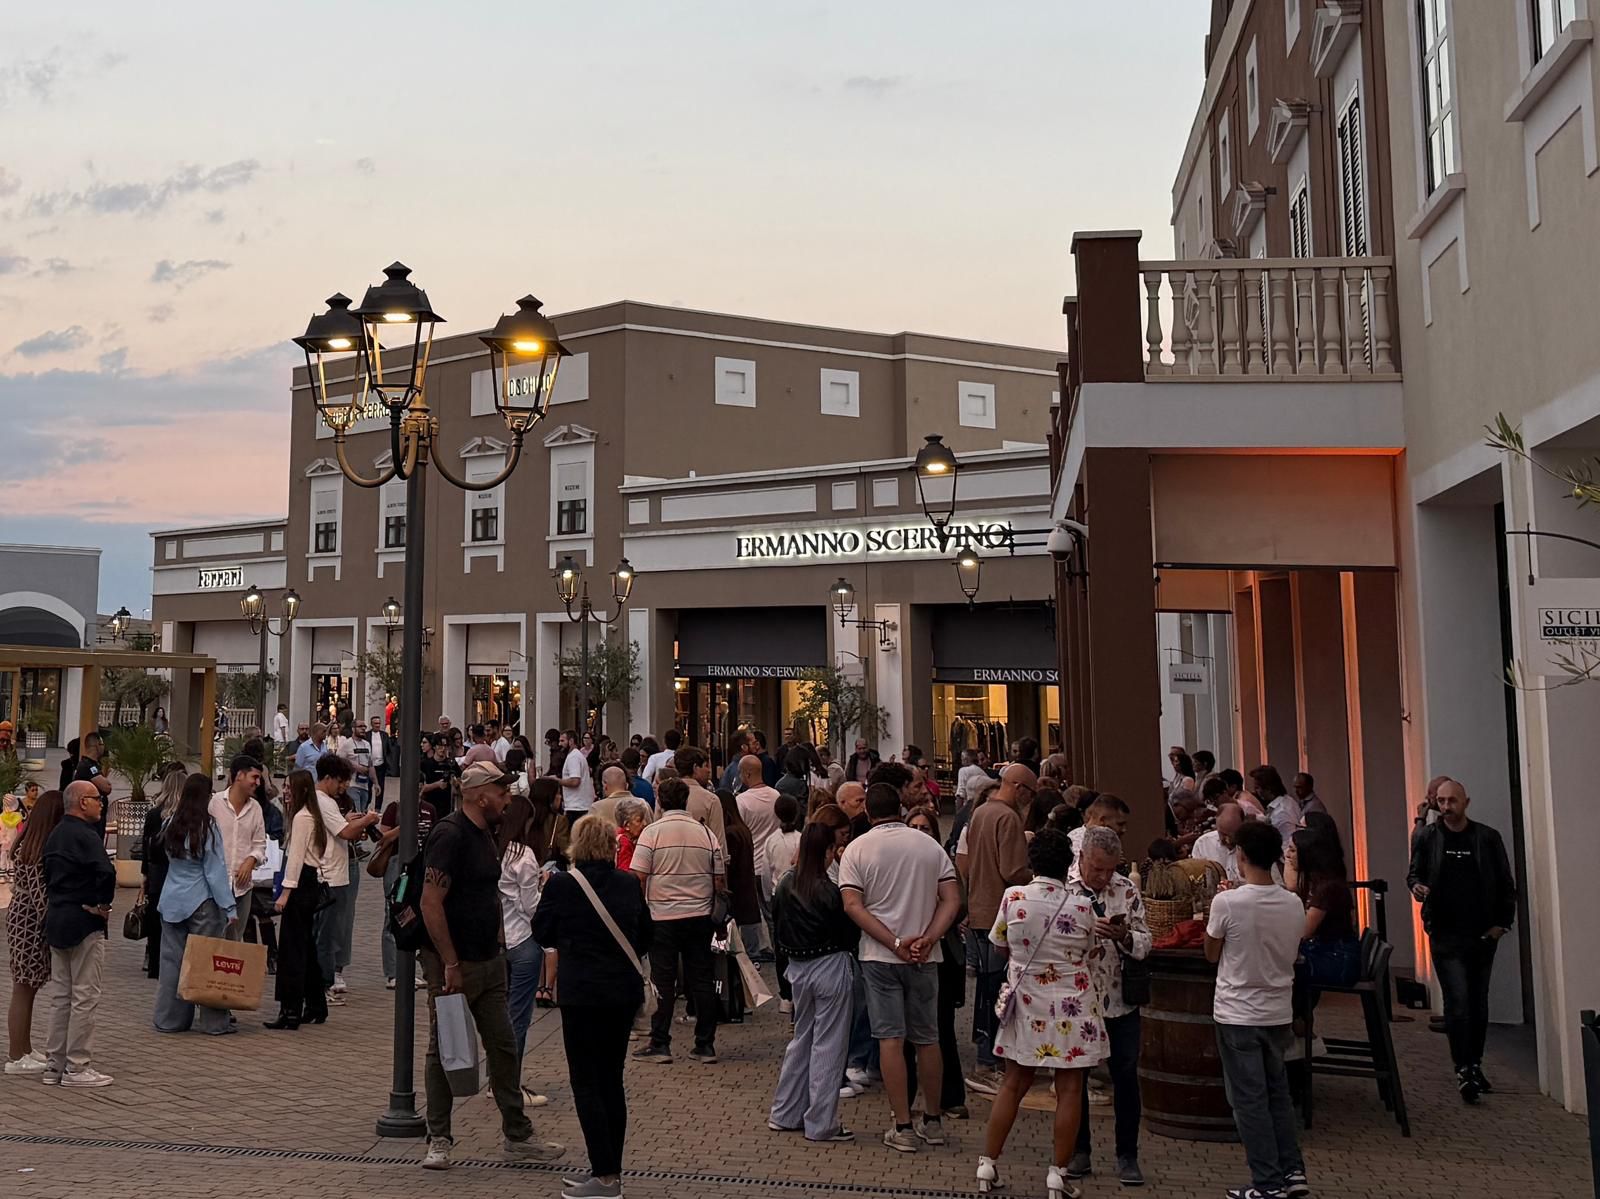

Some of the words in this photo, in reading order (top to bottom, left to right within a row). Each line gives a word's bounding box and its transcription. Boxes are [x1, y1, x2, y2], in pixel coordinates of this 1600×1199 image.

[736, 532, 859, 558] ERMANNO
[1545, 627, 1586, 636] OUTLET
[708, 665, 760, 676] ERMANNO
[974, 669, 1043, 681] ERMANNO
